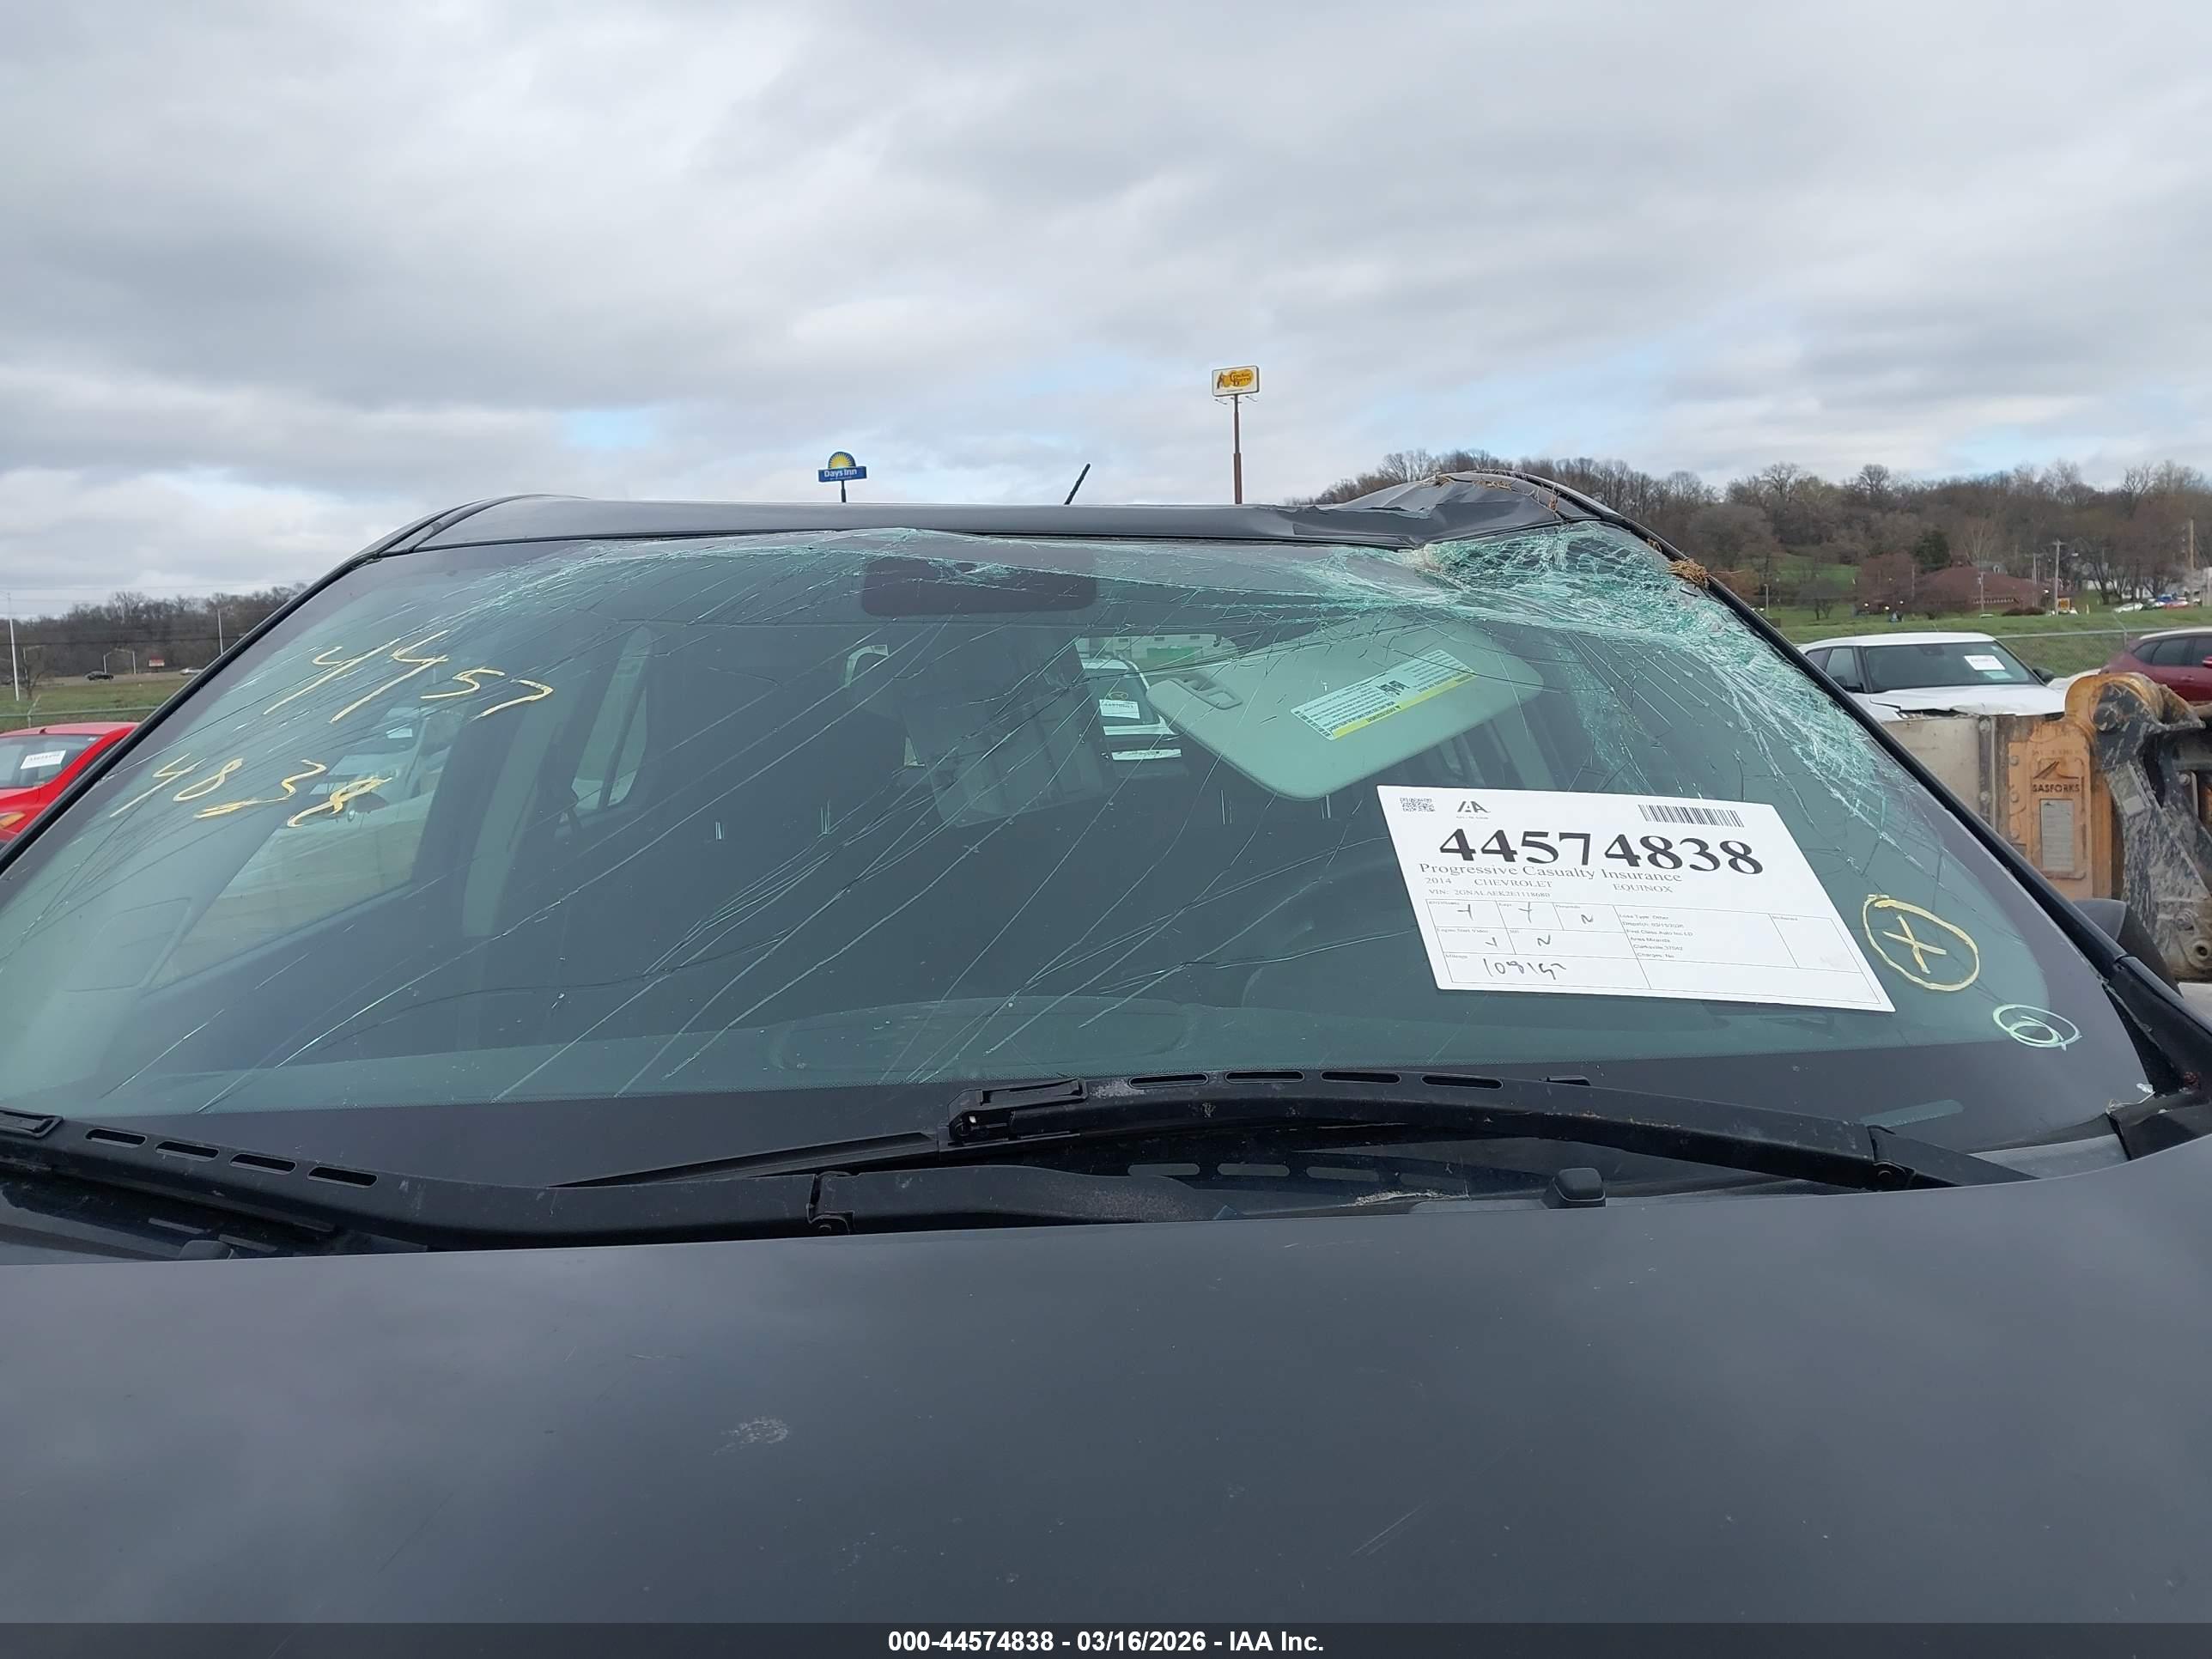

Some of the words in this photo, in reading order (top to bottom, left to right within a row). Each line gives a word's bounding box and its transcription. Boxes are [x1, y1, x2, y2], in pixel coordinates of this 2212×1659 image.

[824, 470, 842, 479] Days
[2033, 783, 2080, 793] SASFORKS
[1439, 828, 1763, 875] 44574838
[1419, 863, 1517, 876] Progressive
[1522, 865, 1595, 880] Casualty
[1601, 868, 1682, 882] Insurance
[1474, 878, 1553, 888] CHEVROLET
[1613, 883, 1673, 893] EQUINOX
